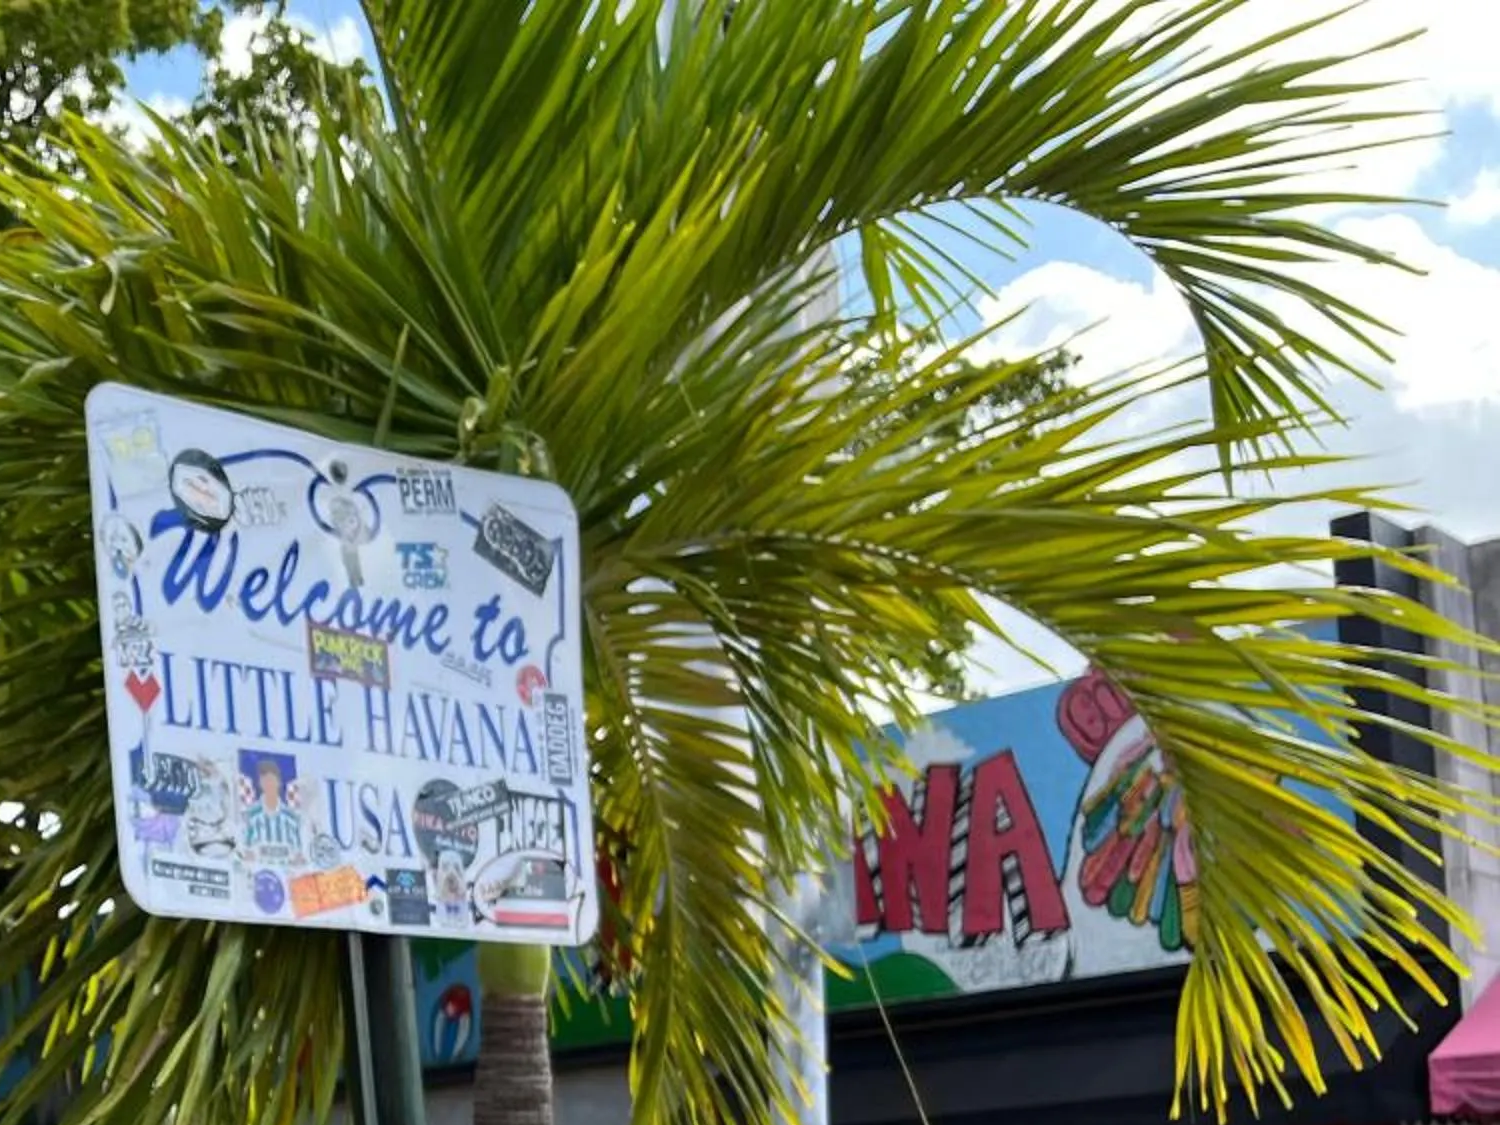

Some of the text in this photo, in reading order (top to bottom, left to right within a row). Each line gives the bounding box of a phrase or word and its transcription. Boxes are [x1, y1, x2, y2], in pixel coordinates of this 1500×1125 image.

[150, 507, 451, 655] Welcome
[471, 594, 529, 664] to
[158, 651, 344, 748] LITTLE
[364, 682, 539, 776] HAVANA
[323, 777, 414, 859] USA
